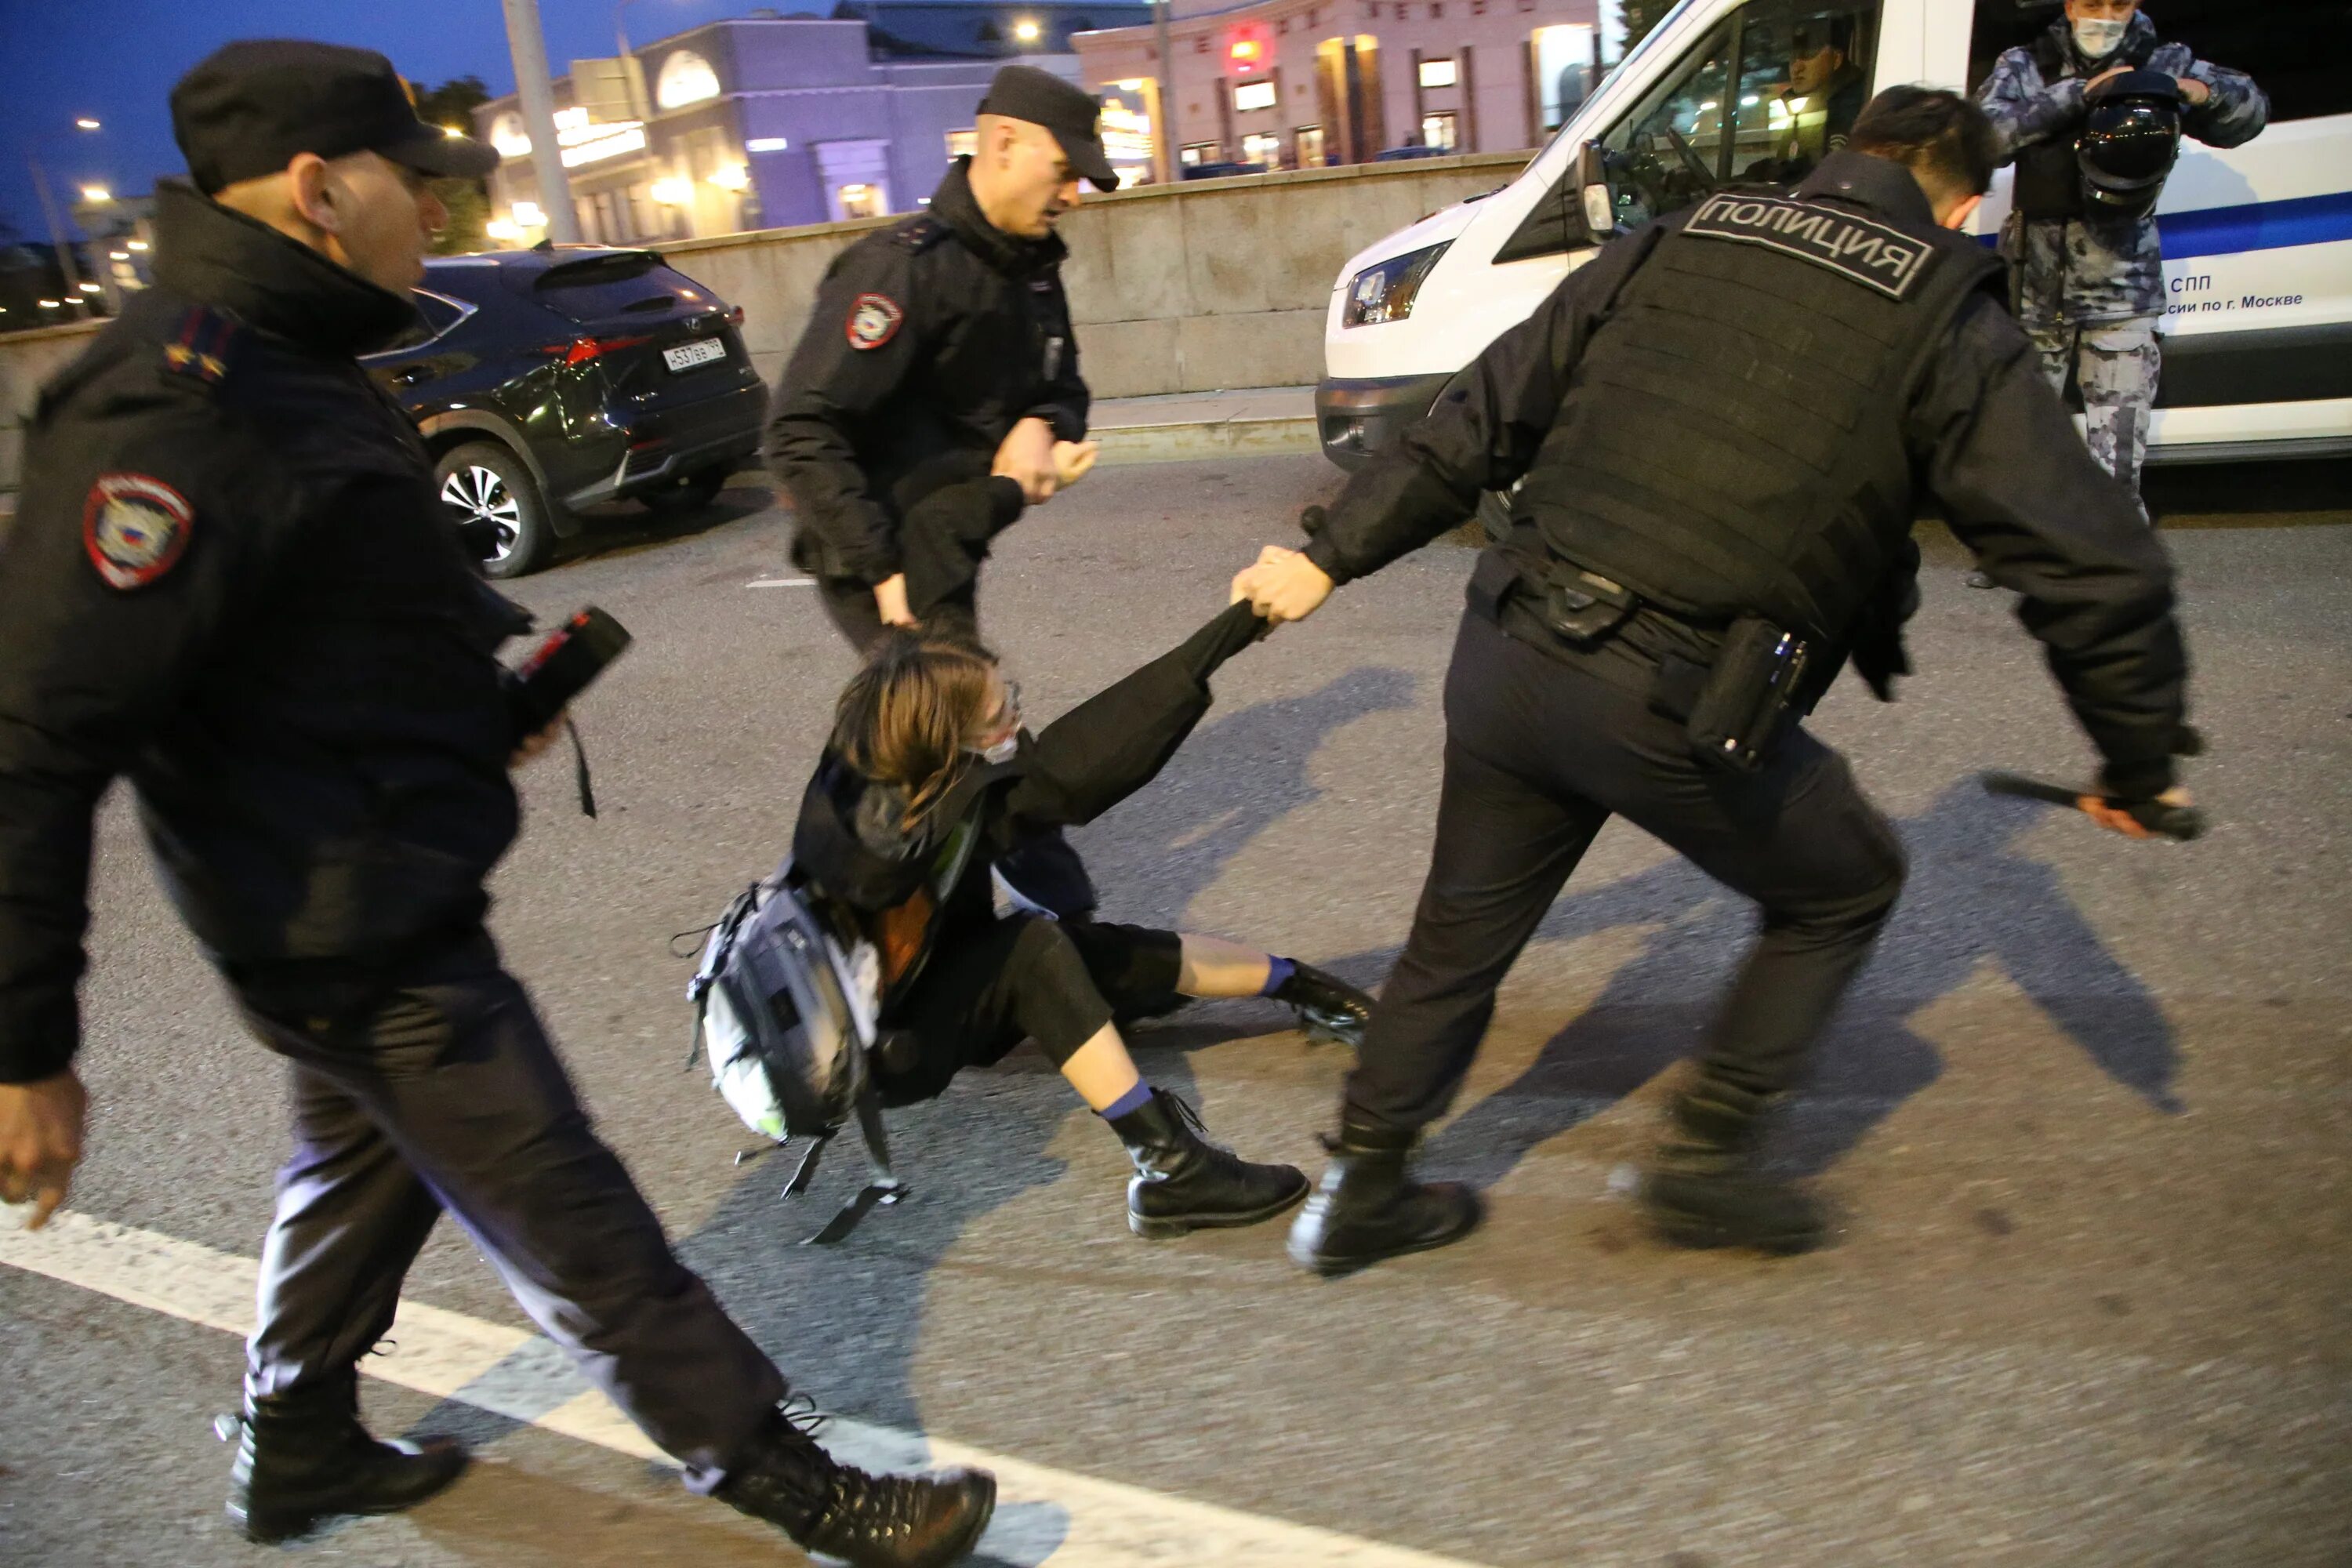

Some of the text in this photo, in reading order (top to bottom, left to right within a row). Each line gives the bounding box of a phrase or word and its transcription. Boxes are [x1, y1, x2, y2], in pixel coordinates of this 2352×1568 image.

[1700, 201, 1915, 278] ПОЛИЦИЯ
[2170, 275, 2211, 293] СПП
[2201, 301, 2221, 312] по
[2227, 299, 2236, 310] г.
[2241, 295, 2303, 309] Москве
